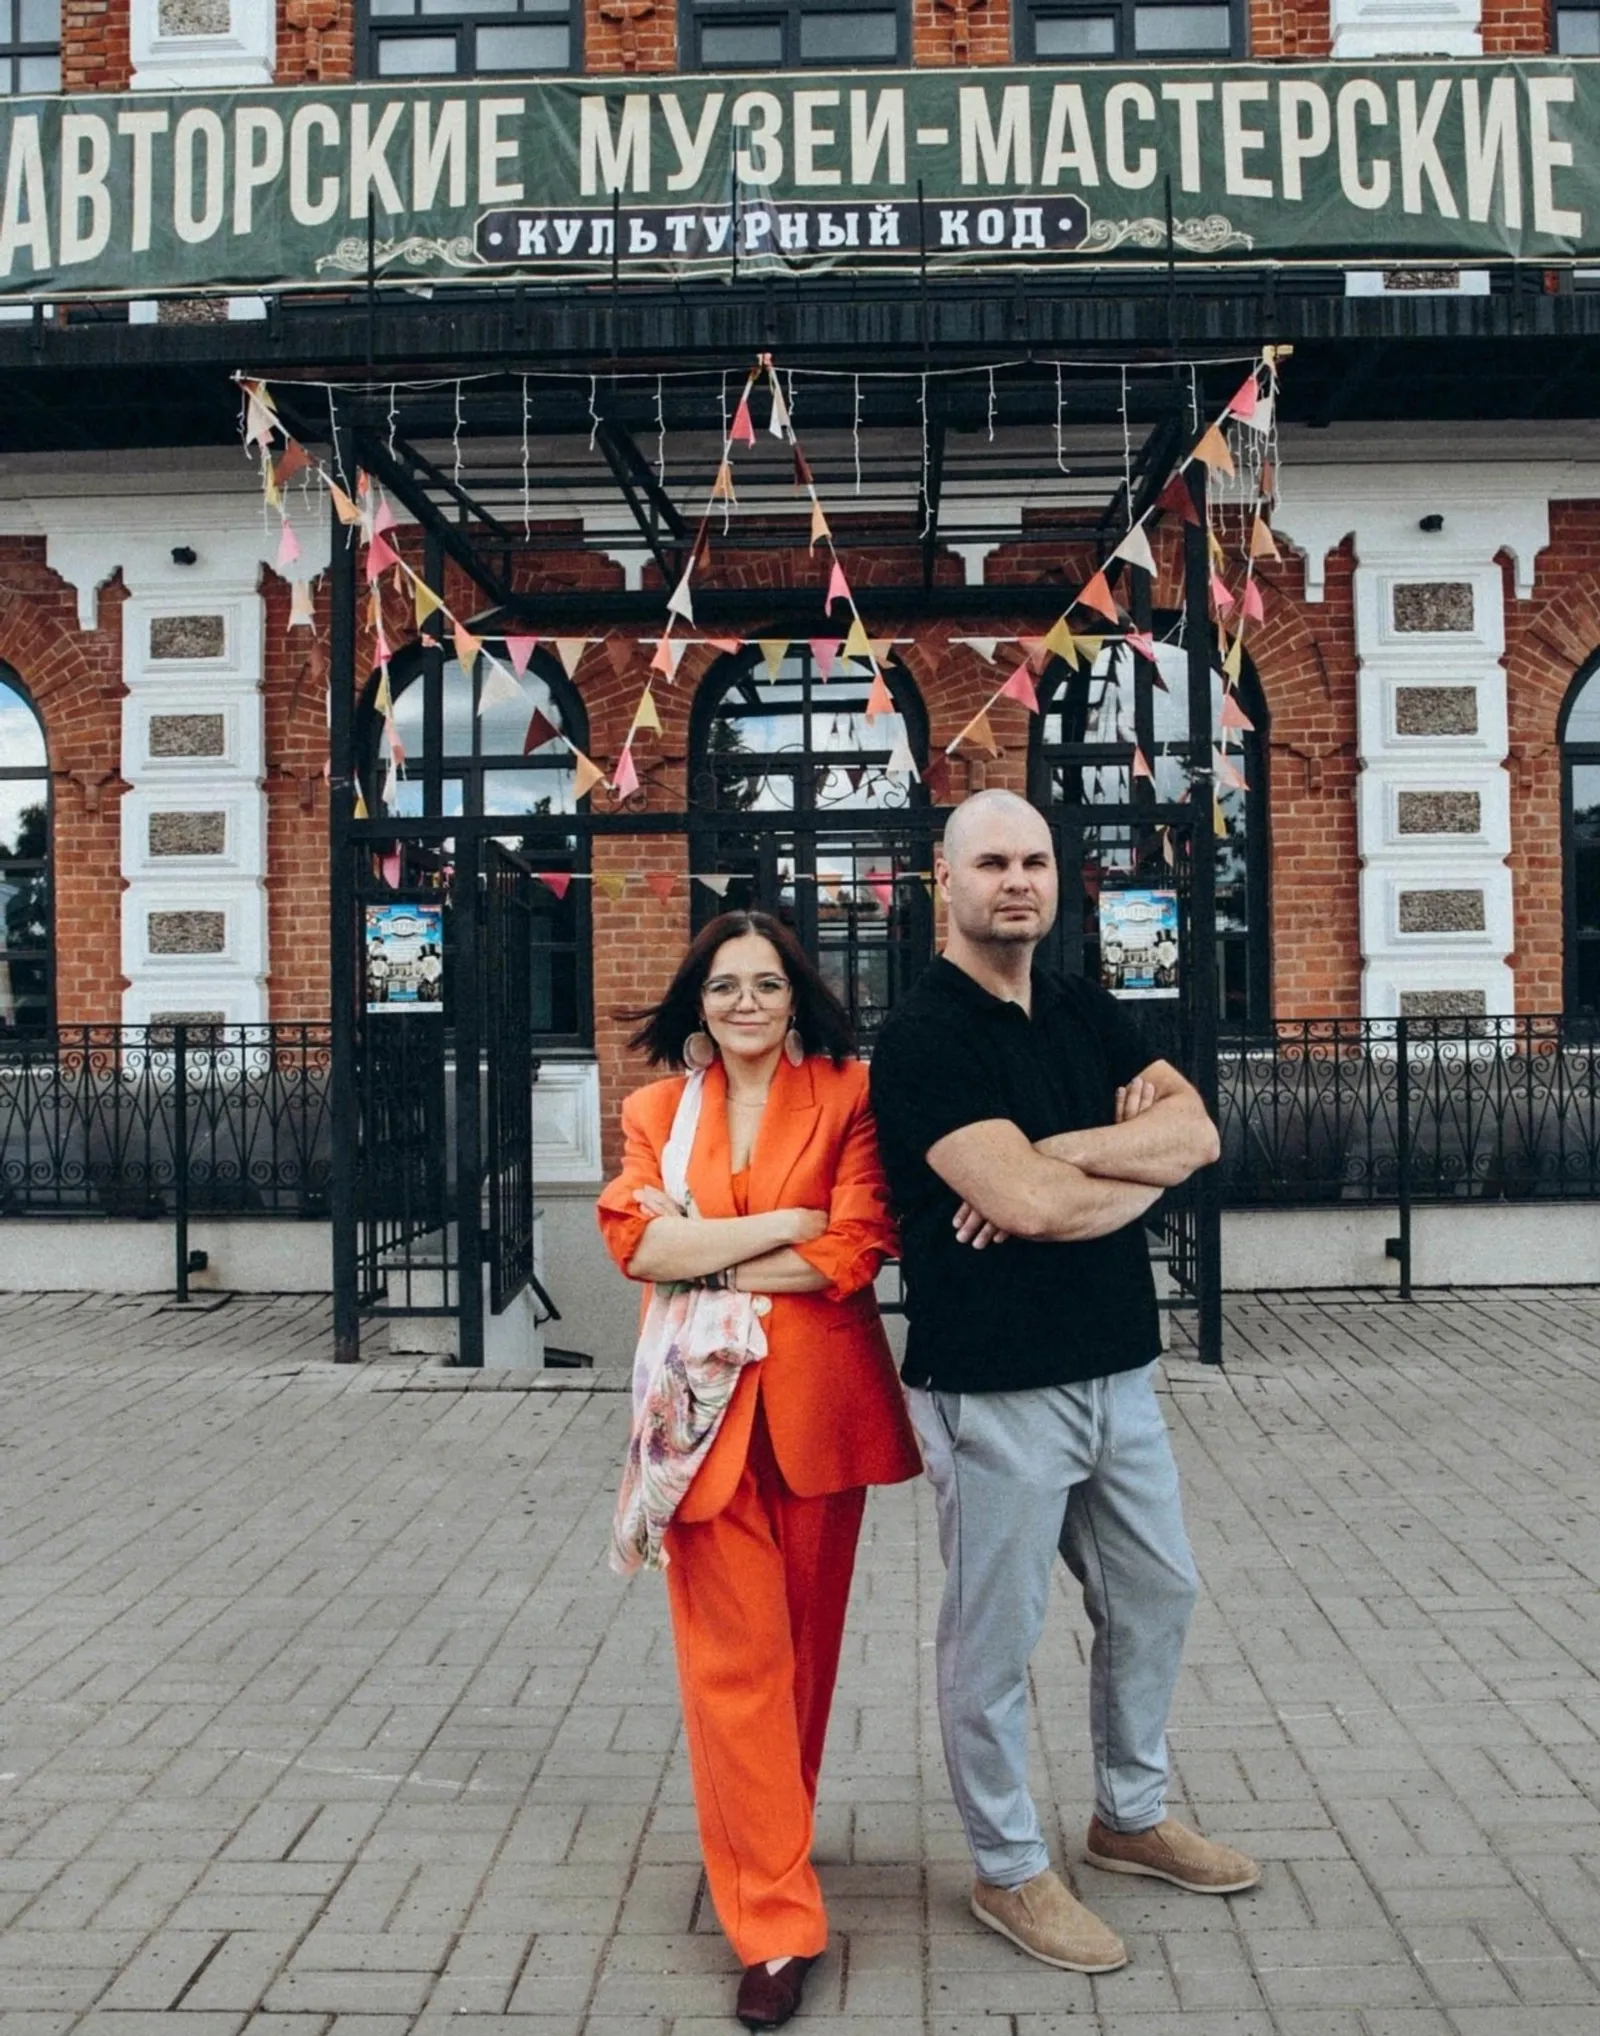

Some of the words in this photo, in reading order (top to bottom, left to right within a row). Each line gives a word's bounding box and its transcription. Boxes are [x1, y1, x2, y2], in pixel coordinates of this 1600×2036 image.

[0, 99, 524, 276] АВТОРСКИЕ
[579, 76, 1582, 239] МУЗЕИ-МАСТЕРСКИЕ
[517, 205, 900, 256] КУЛЬТУРНЫЙ
[940, 207, 1047, 249] КОД
